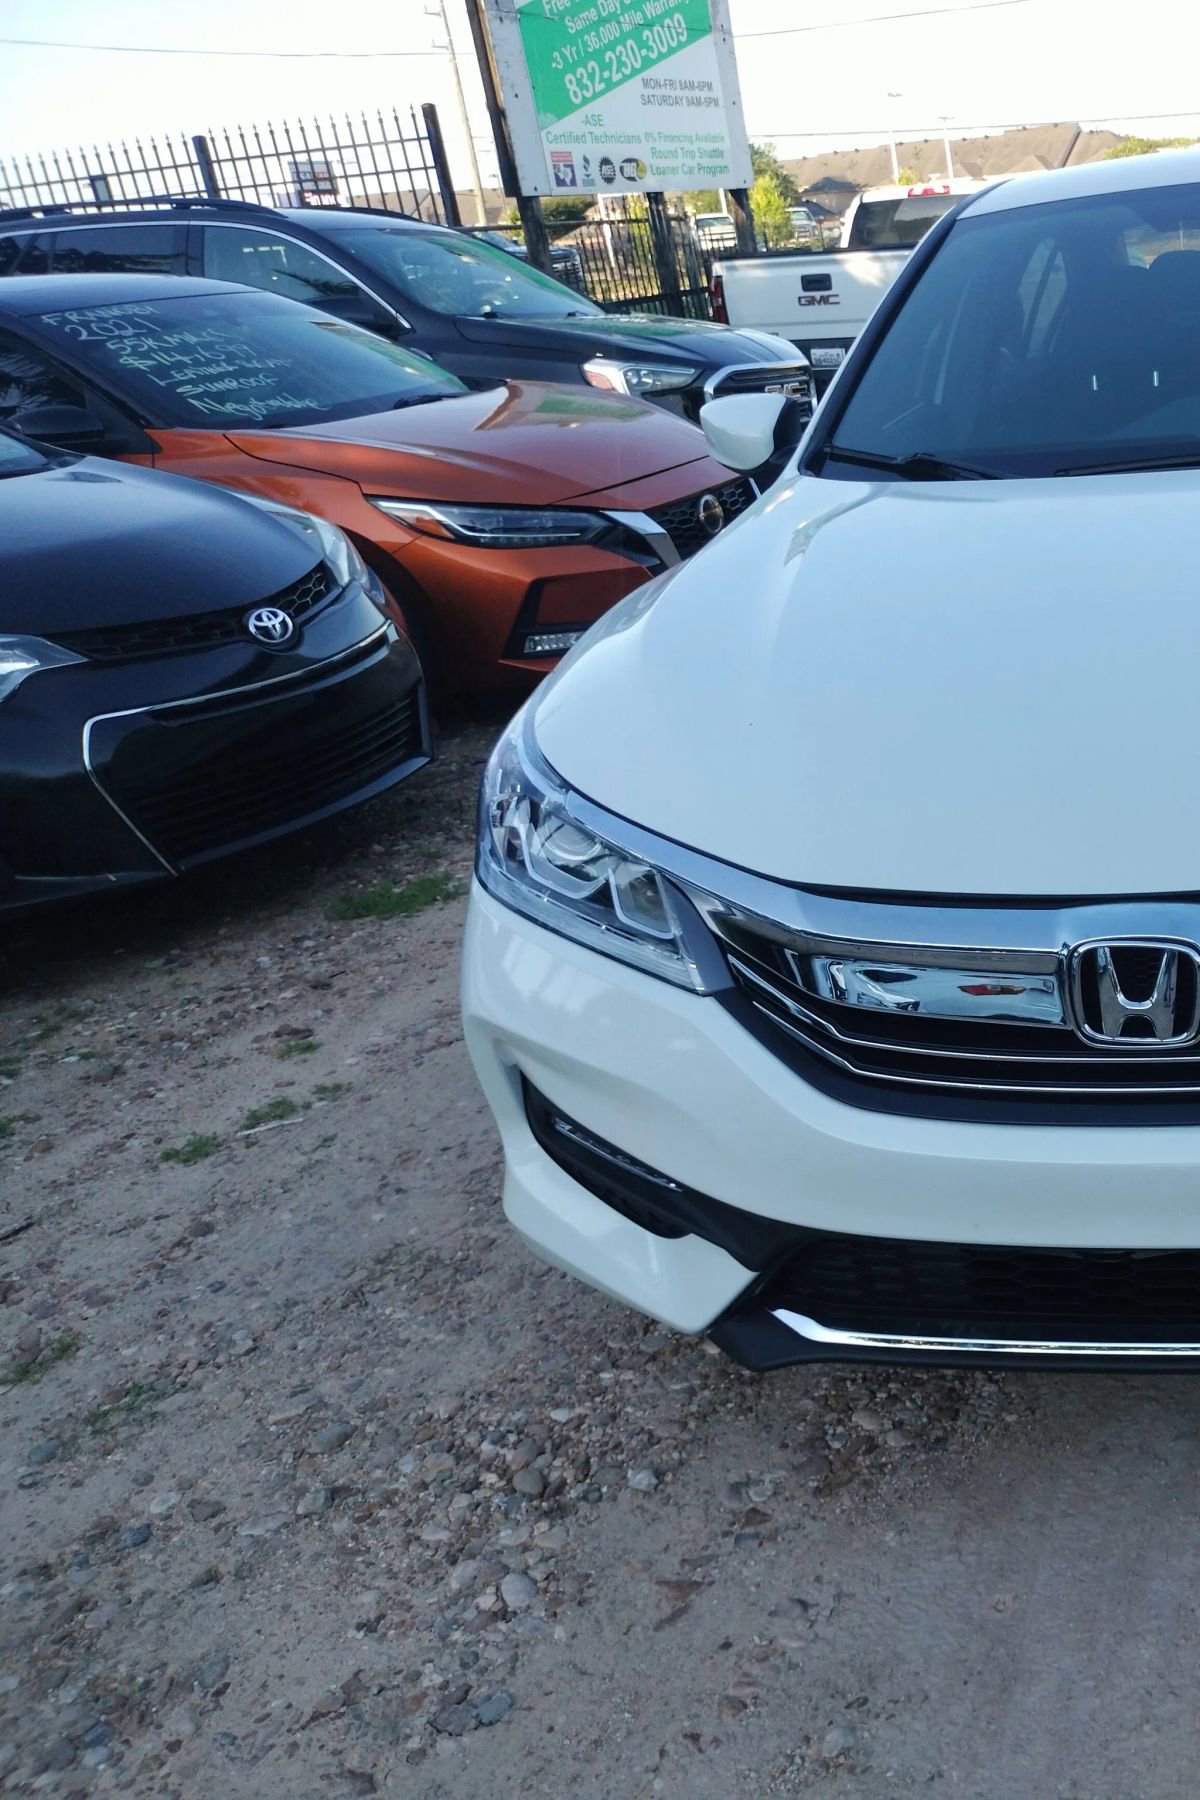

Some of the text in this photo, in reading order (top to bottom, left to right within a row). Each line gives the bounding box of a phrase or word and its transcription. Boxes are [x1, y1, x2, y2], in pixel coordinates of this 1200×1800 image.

[564, 0, 621, 33] Same Day
[562, 43, 578, 64] Yr
[584, 20, 621, 53] 36,000
[619, 10, 644, 33] Mile
[564, 12, 688, 104] 832-230-3009
[642, 78, 678, 92] MON-FRI
[640, 94, 684, 107] SATURDAY
[546, 131, 642, 145] Certified Technicians
[658, 132, 694, 146] Financing
[695, 132, 725, 144] Available
[651, 147, 724, 162] Round Trip Shuttle
[651, 164, 730, 178] Loaner Car Program
[798, 294, 840, 306] GMC
[64, 318, 161, 341] 2021
